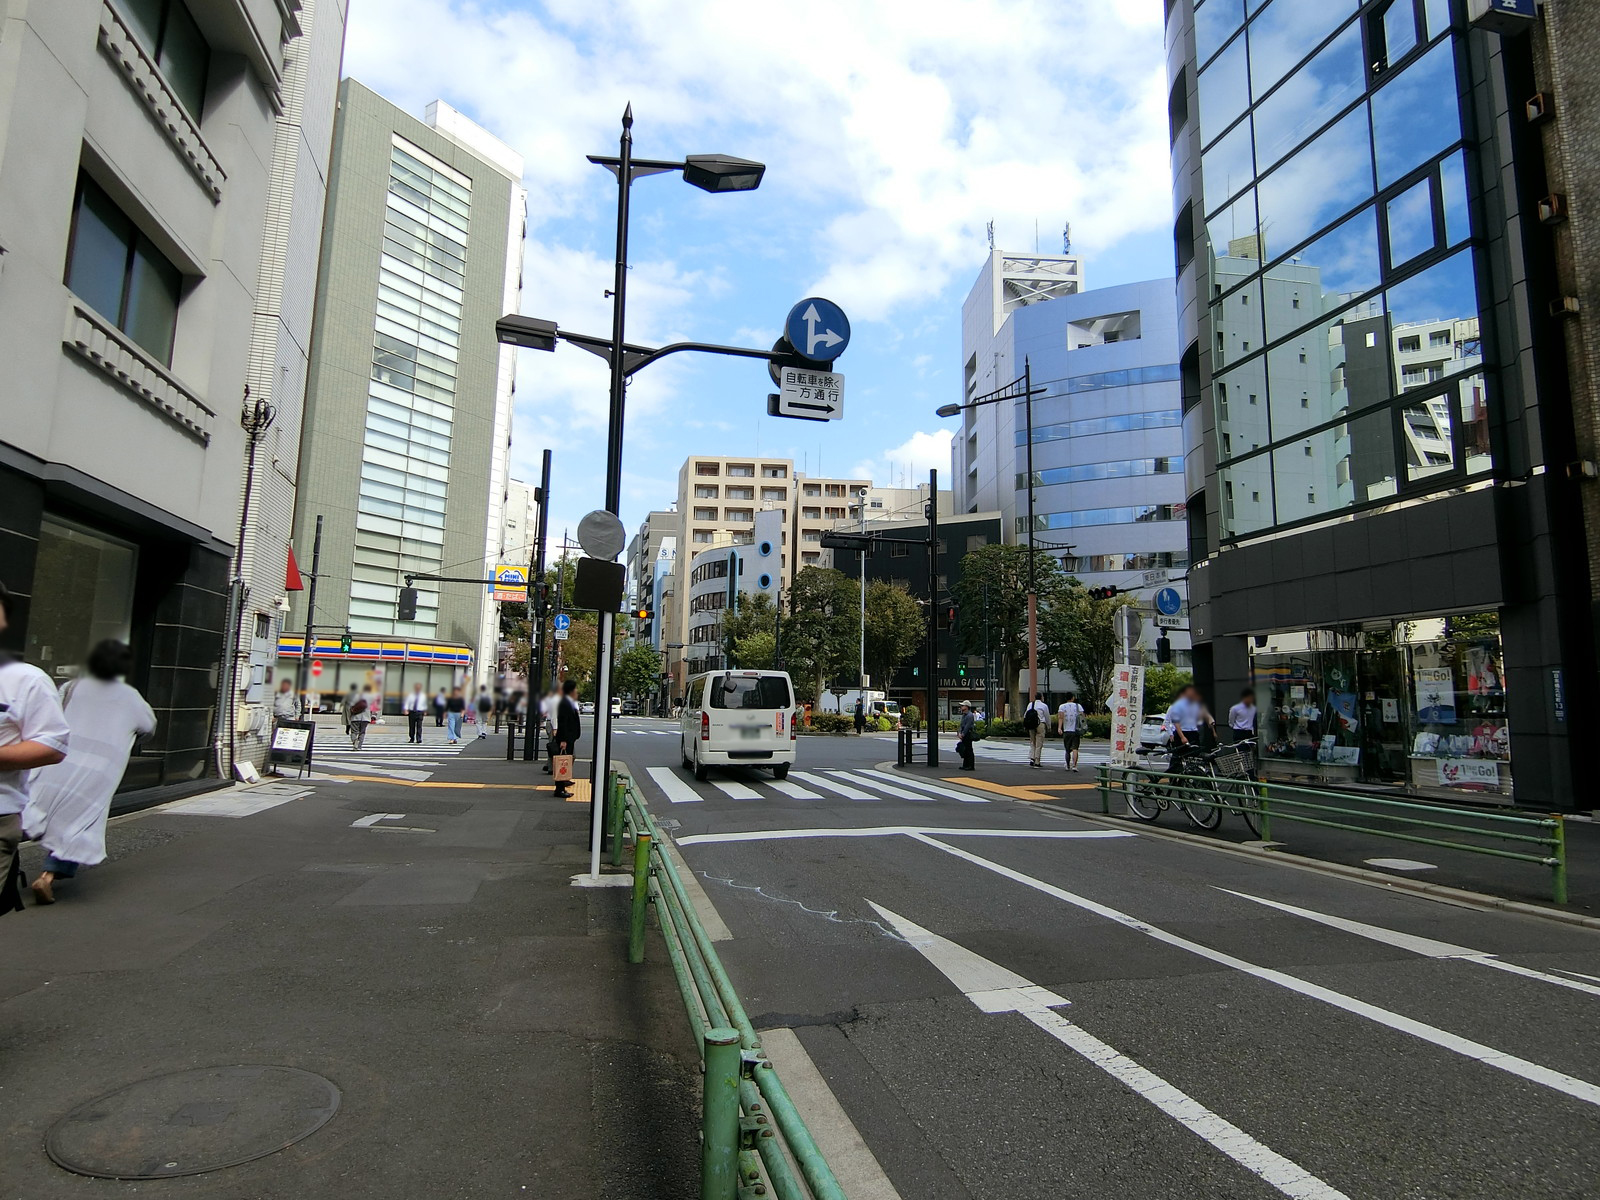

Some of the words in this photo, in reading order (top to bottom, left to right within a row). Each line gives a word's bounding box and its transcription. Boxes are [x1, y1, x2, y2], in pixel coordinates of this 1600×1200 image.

[786, 372, 839, 388] 自転車を除く
[786, 388, 839, 402] 一方通行
[1433, 669, 1451, 681] Go!
[1478, 765, 1495, 777] Go!
